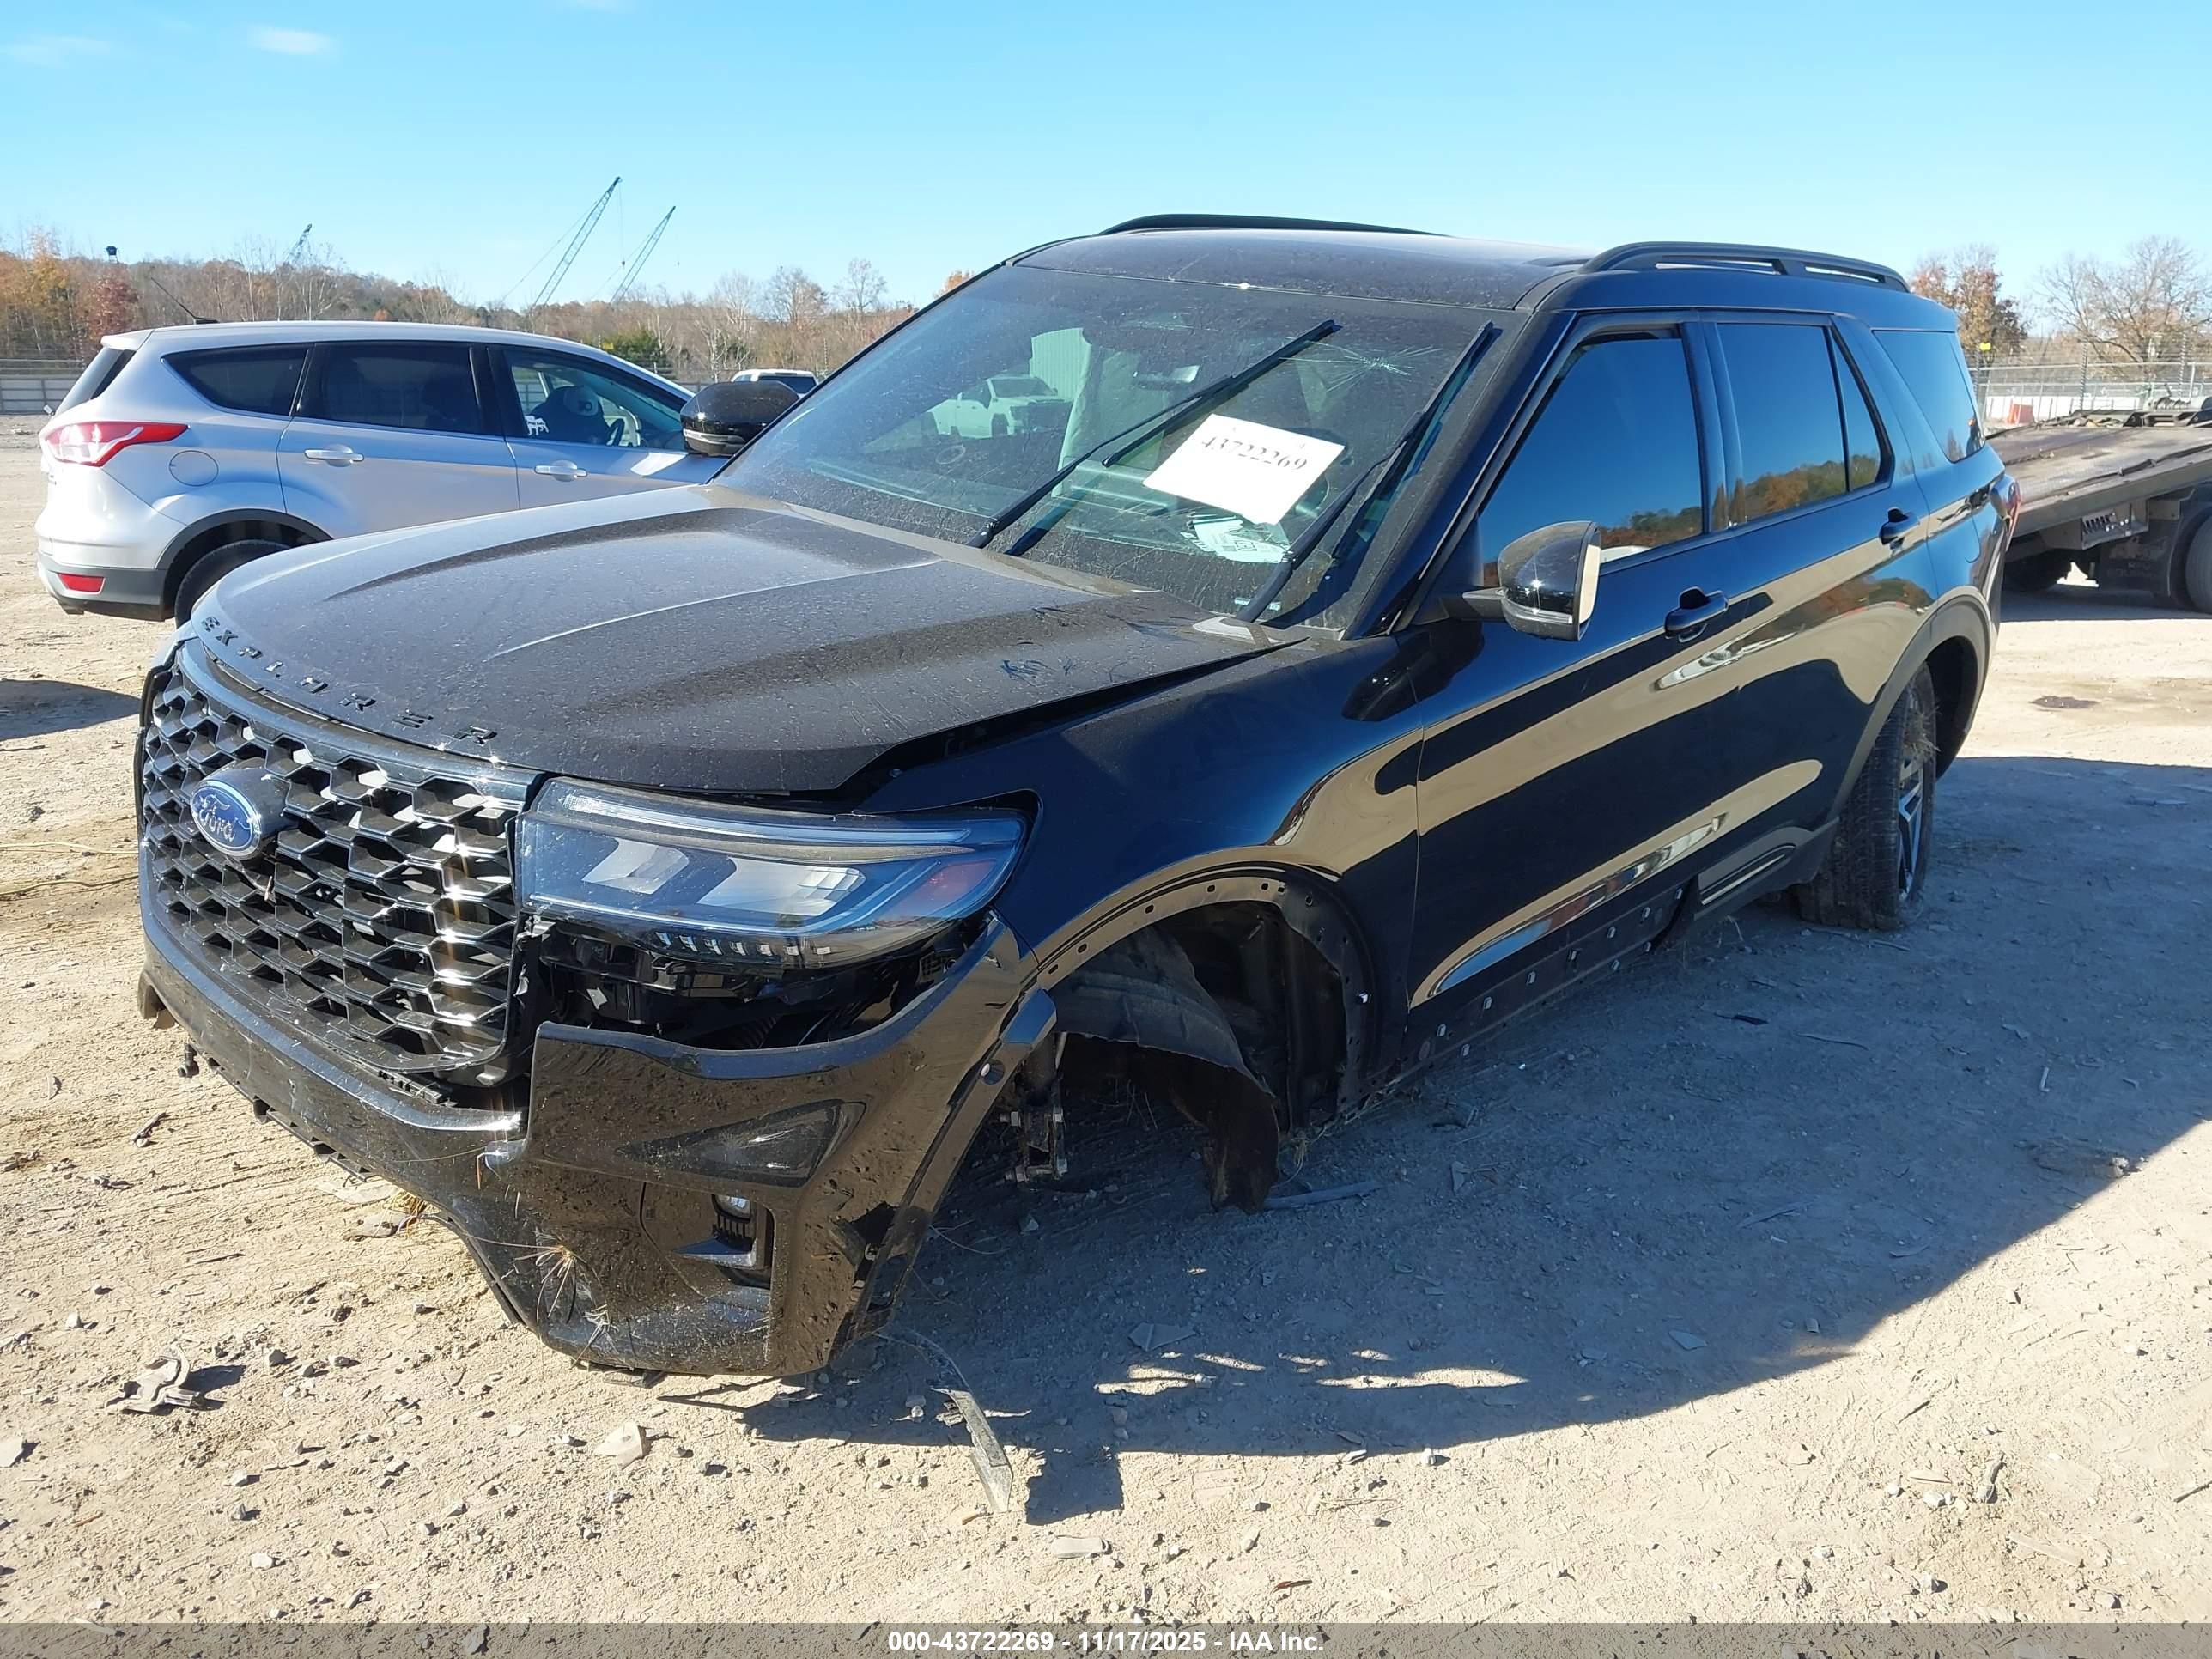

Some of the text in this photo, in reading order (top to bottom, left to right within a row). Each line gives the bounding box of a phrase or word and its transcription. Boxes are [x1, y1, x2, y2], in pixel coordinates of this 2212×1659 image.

[1202, 436, 1308, 470] 43722269
[200, 616, 498, 746] EXPLORER
[198, 794, 250, 842] Ford
